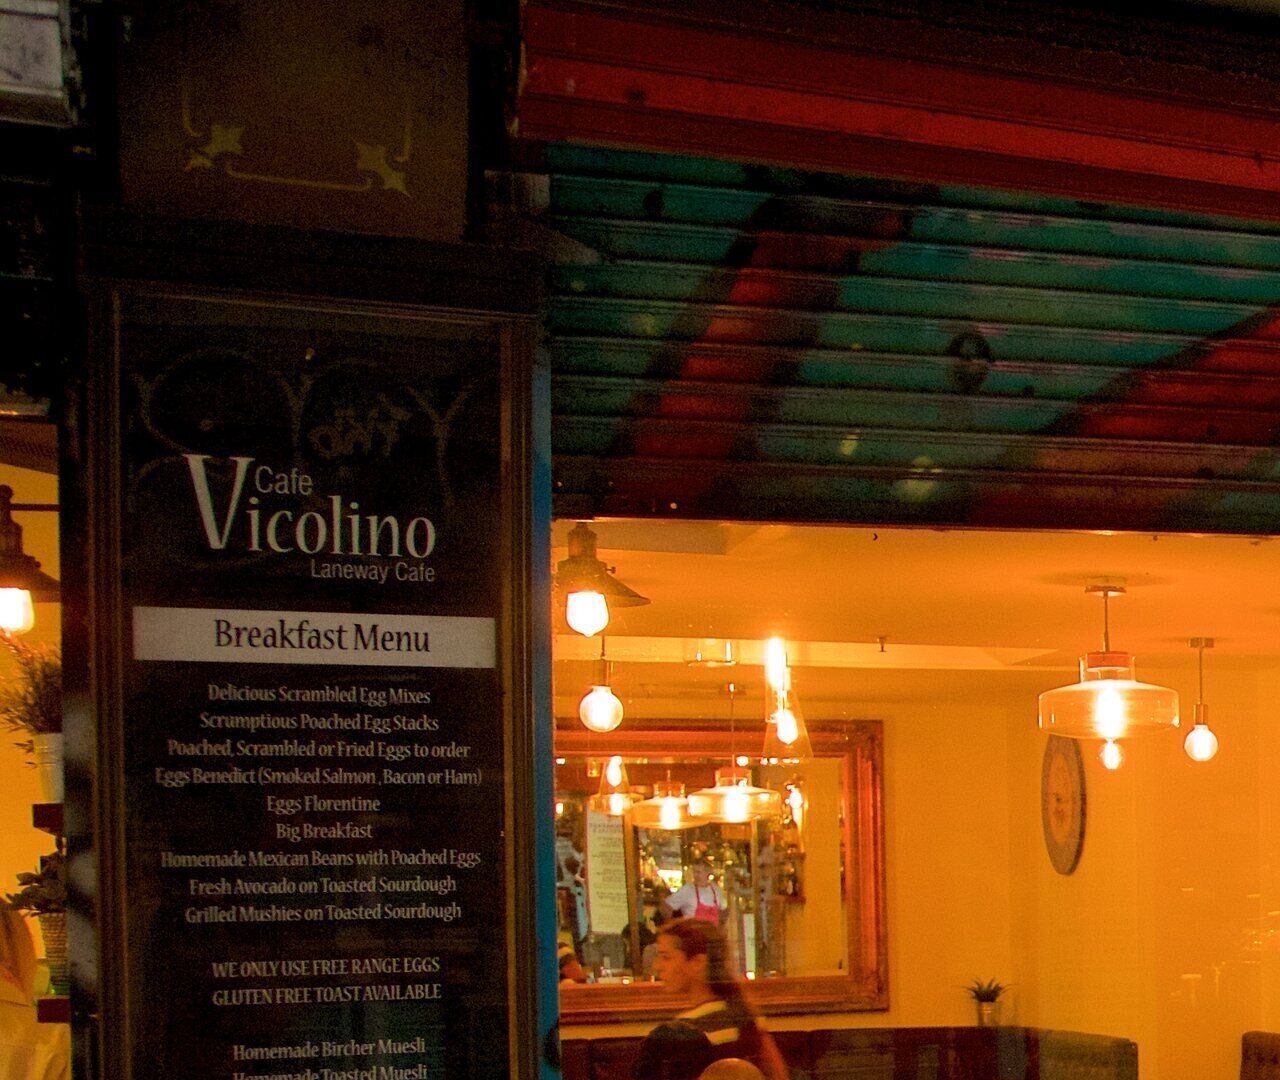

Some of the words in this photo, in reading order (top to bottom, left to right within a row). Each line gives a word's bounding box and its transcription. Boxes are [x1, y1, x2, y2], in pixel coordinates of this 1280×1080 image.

[255, 466, 313, 495] Cafe
[182, 454, 435, 558] Vicolino
[310, 558, 390, 583] Laneway
[395, 561, 435, 582] Cafe
[214, 619, 348, 649] Breakfast
[353, 623, 430, 651] Menu
[208, 685, 276, 701] Delicious
[279, 686, 357, 702] Scrambled
[359, 688, 387, 707] Egg
[390, 689, 430, 704] Mixes
[267, 796, 301, 815] Eggs
[304, 796, 380, 811] Florentine
[276, 823, 300, 842] Big
[303, 823, 373, 839] Breakfast
[190, 879, 231, 895] Fresh
[234, 878, 295, 894] Avocado
[299, 881, 317, 893] on
[320, 878, 376, 892] Toasted
[379, 876, 456, 895] Sourdough
[213, 963, 238, 978] WE
[241, 961, 280, 977] ONLY
[282, 961, 310, 976] USE
[313, 960, 347, 976] FREE
[352, 958, 401, 974] RANGE
[404, 957, 440, 973] EGGS
[213, 989, 272, 1006] GLUTEN
[276, 988, 312, 1004] FREE
[316, 986, 361, 1002] TOAST
[365, 984, 442, 1001] AVAILABLE
[233, 1044, 319, 1061] Homemade
[322, 1040, 374, 1058] Bircher
[377, 1037, 425, 1055] Muesli
